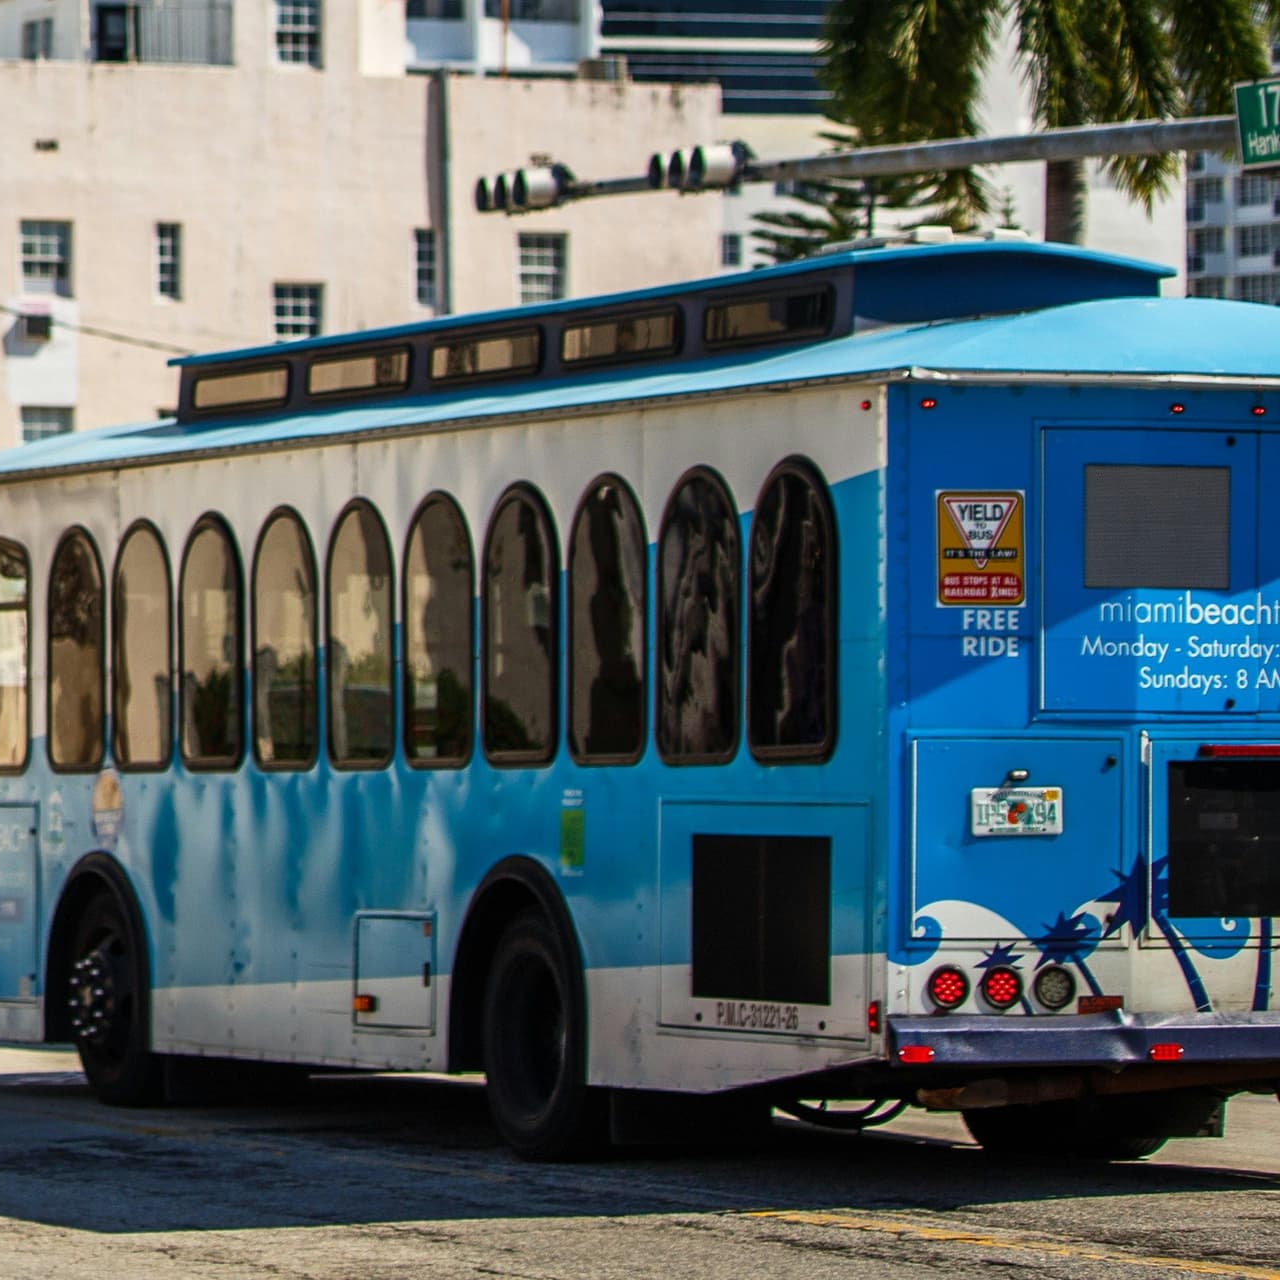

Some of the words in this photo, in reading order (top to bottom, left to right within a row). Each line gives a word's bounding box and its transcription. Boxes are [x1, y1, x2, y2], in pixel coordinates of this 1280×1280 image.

[1259, 85, 1280, 128] 17
[959, 504, 1004, 521] YIELD
[968, 530, 993, 540] BUS
[975, 522, 987, 530] TO
[963, 609, 1019, 631] FREE
[963, 636, 1019, 657] RIDE
[1081, 634, 1169, 663] Monday
[1188, 634, 1280, 665] Saturday:
[1139, 666, 1228, 695] Sundays:
[1236, 668, 1248, 689] 8
